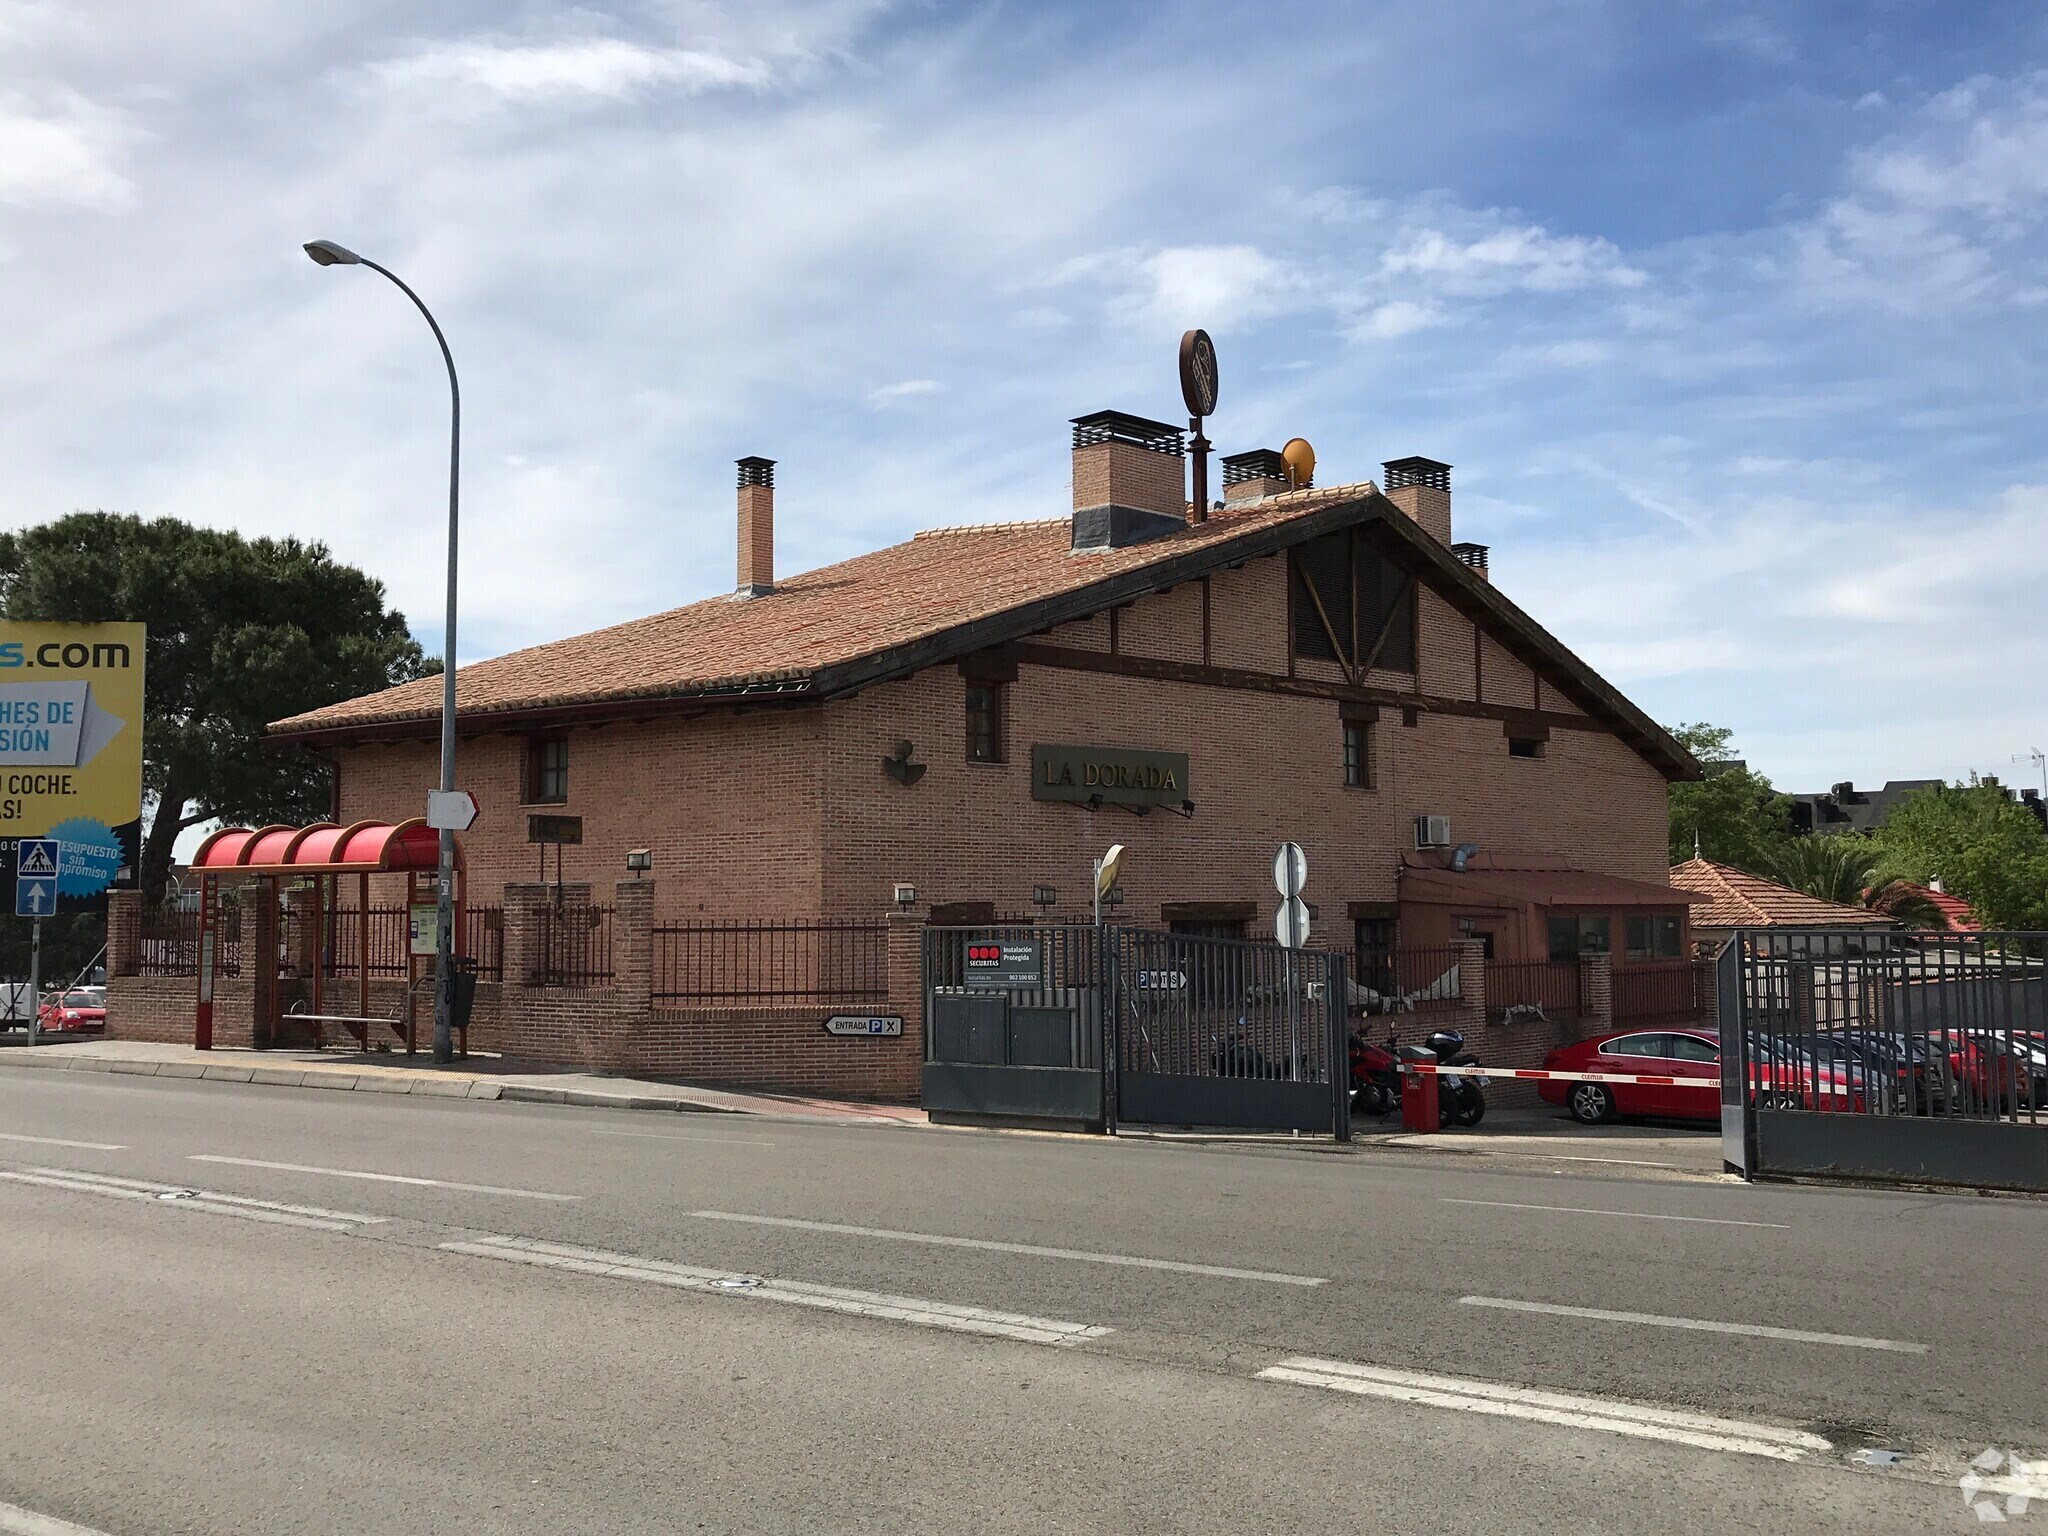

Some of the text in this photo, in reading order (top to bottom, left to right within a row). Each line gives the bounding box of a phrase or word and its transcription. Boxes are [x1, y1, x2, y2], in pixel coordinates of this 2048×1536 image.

[47, 701, 74, 724] DE
[1045, 761, 1177, 789] LA DORADA
[8, 775, 77, 795] COCHE.
[0, 800, 22, 819] S!
[61, 841, 118, 860] ESUPUESTO
[69, 855, 86, 866] sin
[58, 862, 107, 879] mpromiso
[1003, 954, 1030, 962] Protegida
[835, 1020, 881, 1032] ENTRADA P
